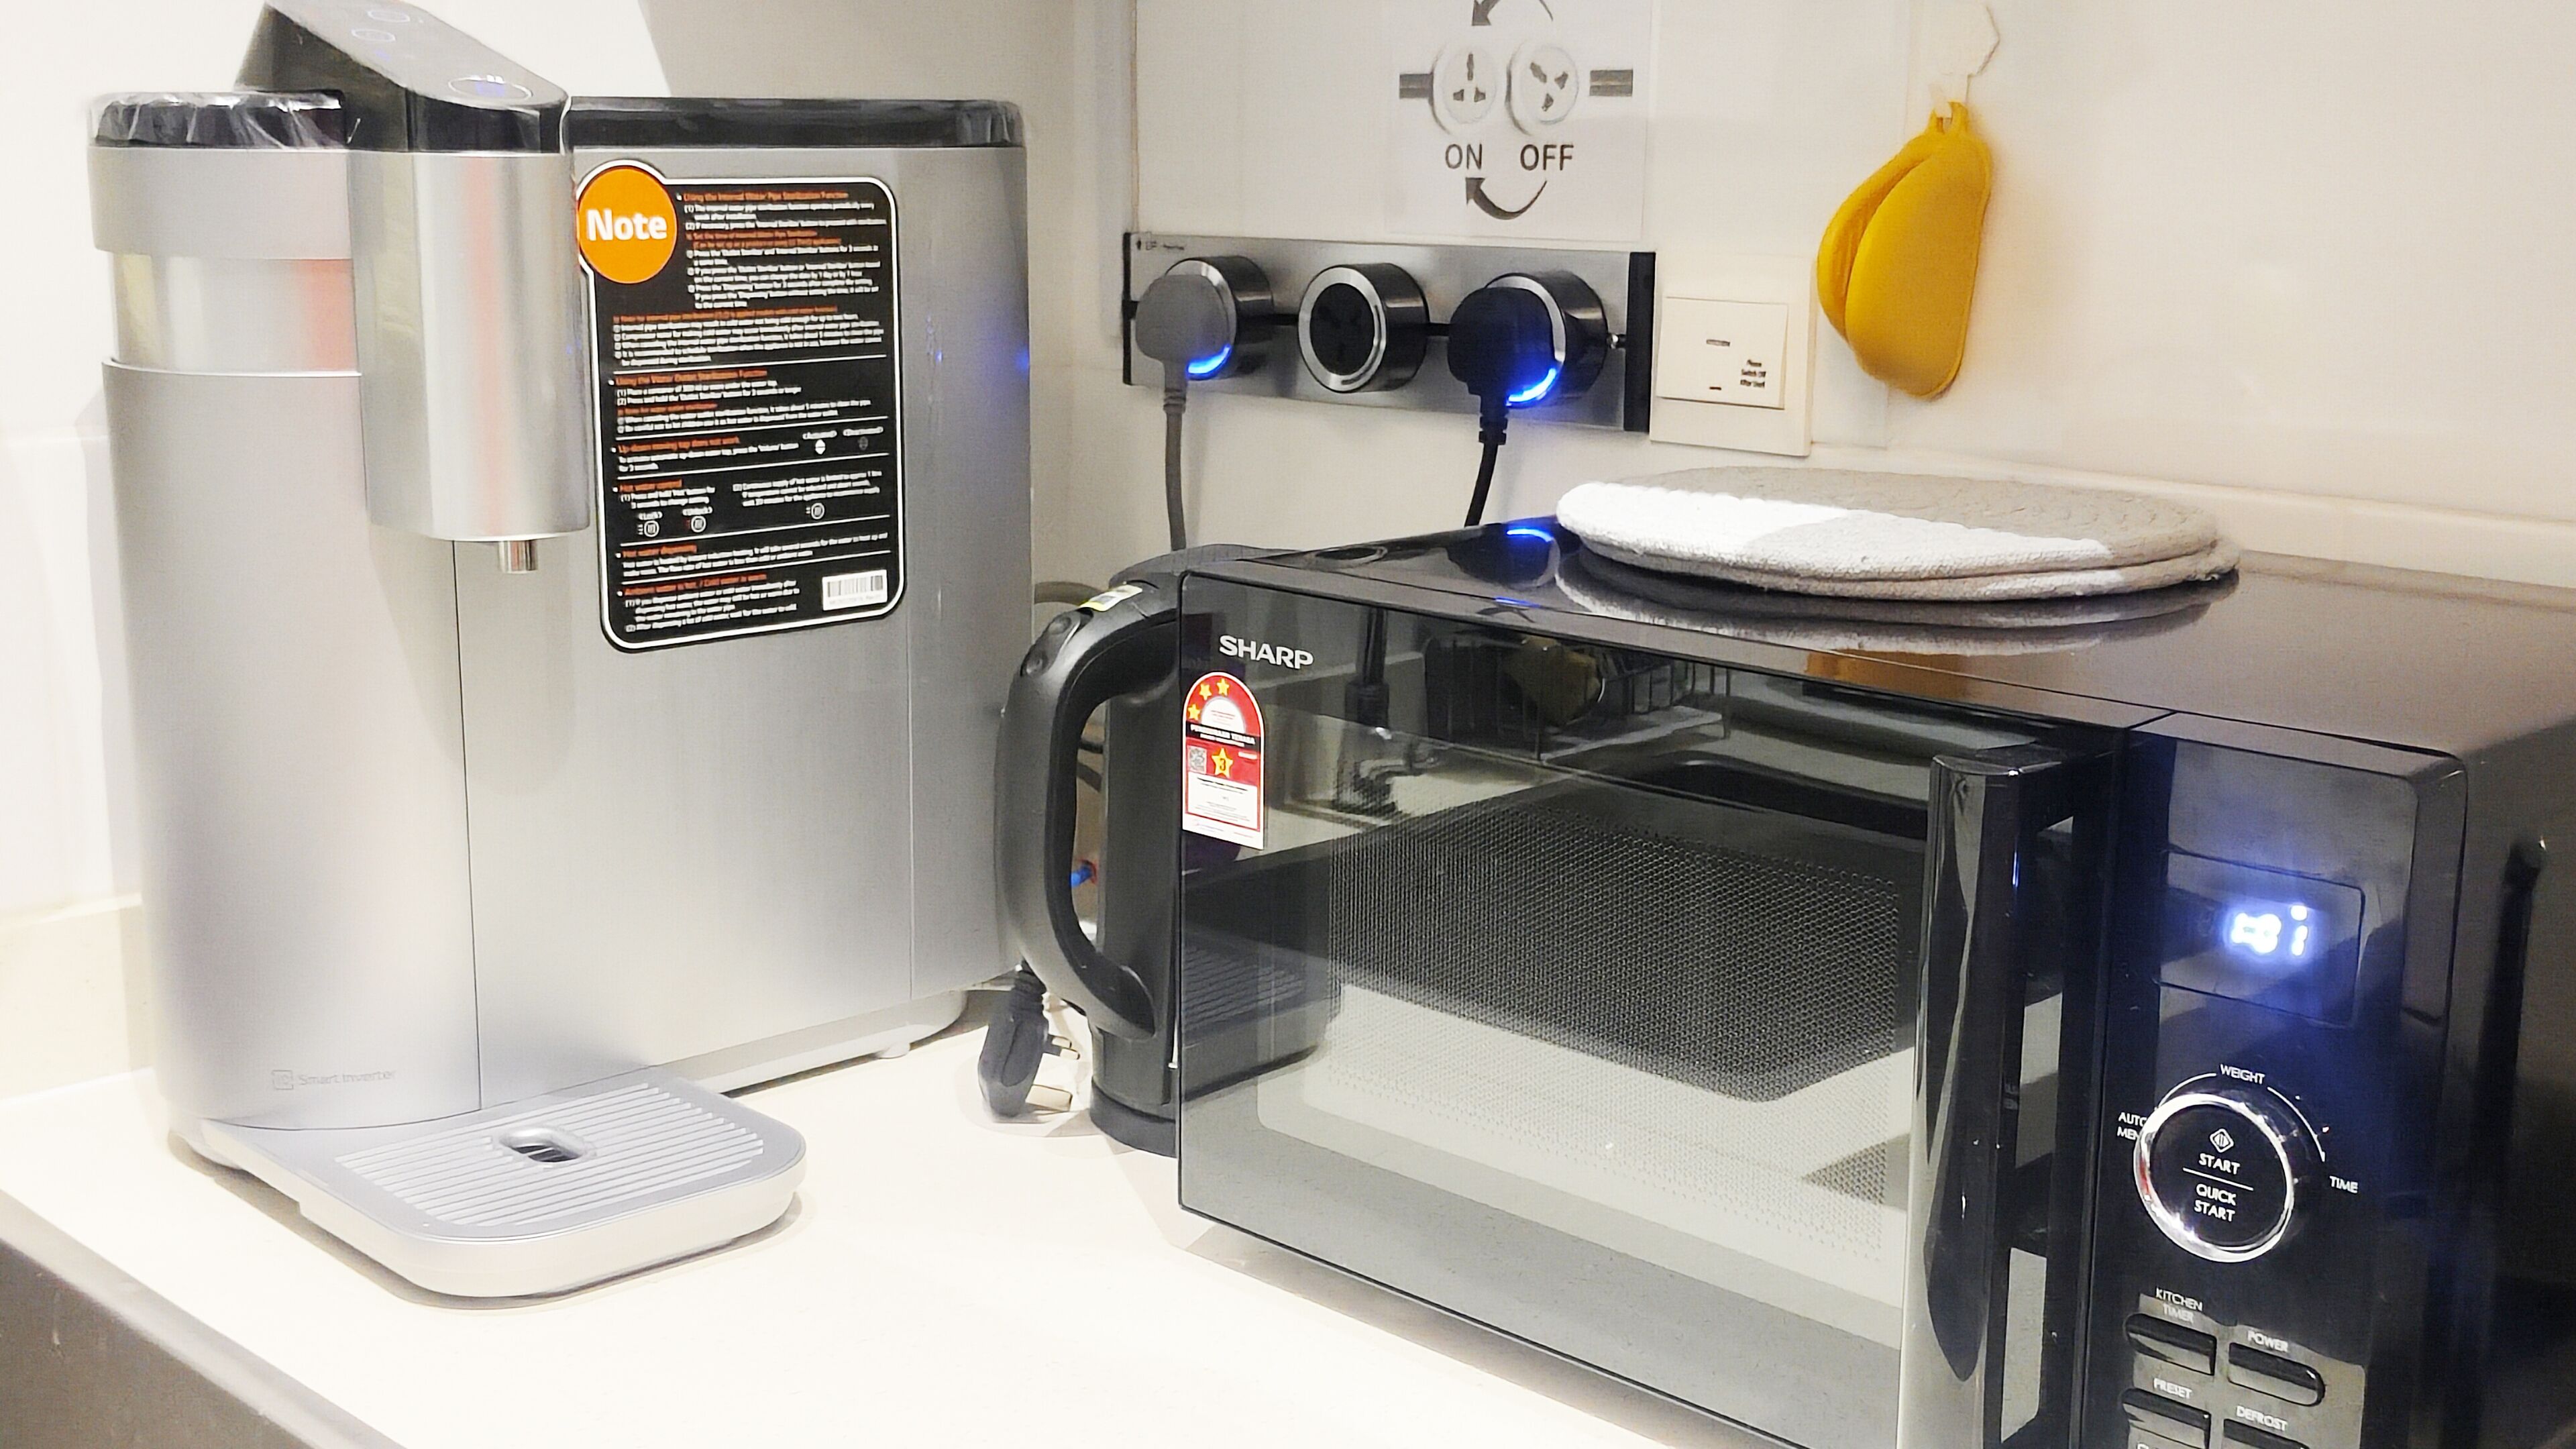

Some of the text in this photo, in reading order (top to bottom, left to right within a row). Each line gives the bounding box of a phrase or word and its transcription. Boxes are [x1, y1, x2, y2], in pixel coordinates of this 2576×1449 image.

[1445, 144, 1574, 170] ON OFF
[587, 208, 667, 241] Note
[1220, 635, 1314, 669] SHARP
[1219, 758, 1226, 771] 3
[2220, 1064, 2265, 1084] WEIGHT
[2198, 1152, 2241, 1175] START
[2196, 1184, 2237, 1205] QUICK
[2329, 1175, 2359, 1193] TIME
[2194, 1200, 2236, 1222] START
[2155, 1287, 2203, 1312] KITCHEN
[2163, 1303, 2195, 1324] TIMER
[2247, 1330, 2289, 1353] POWER
[2153, 1377, 2193, 1400] PRESET
[2236, 1405, 2288, 1432] DEFROST
